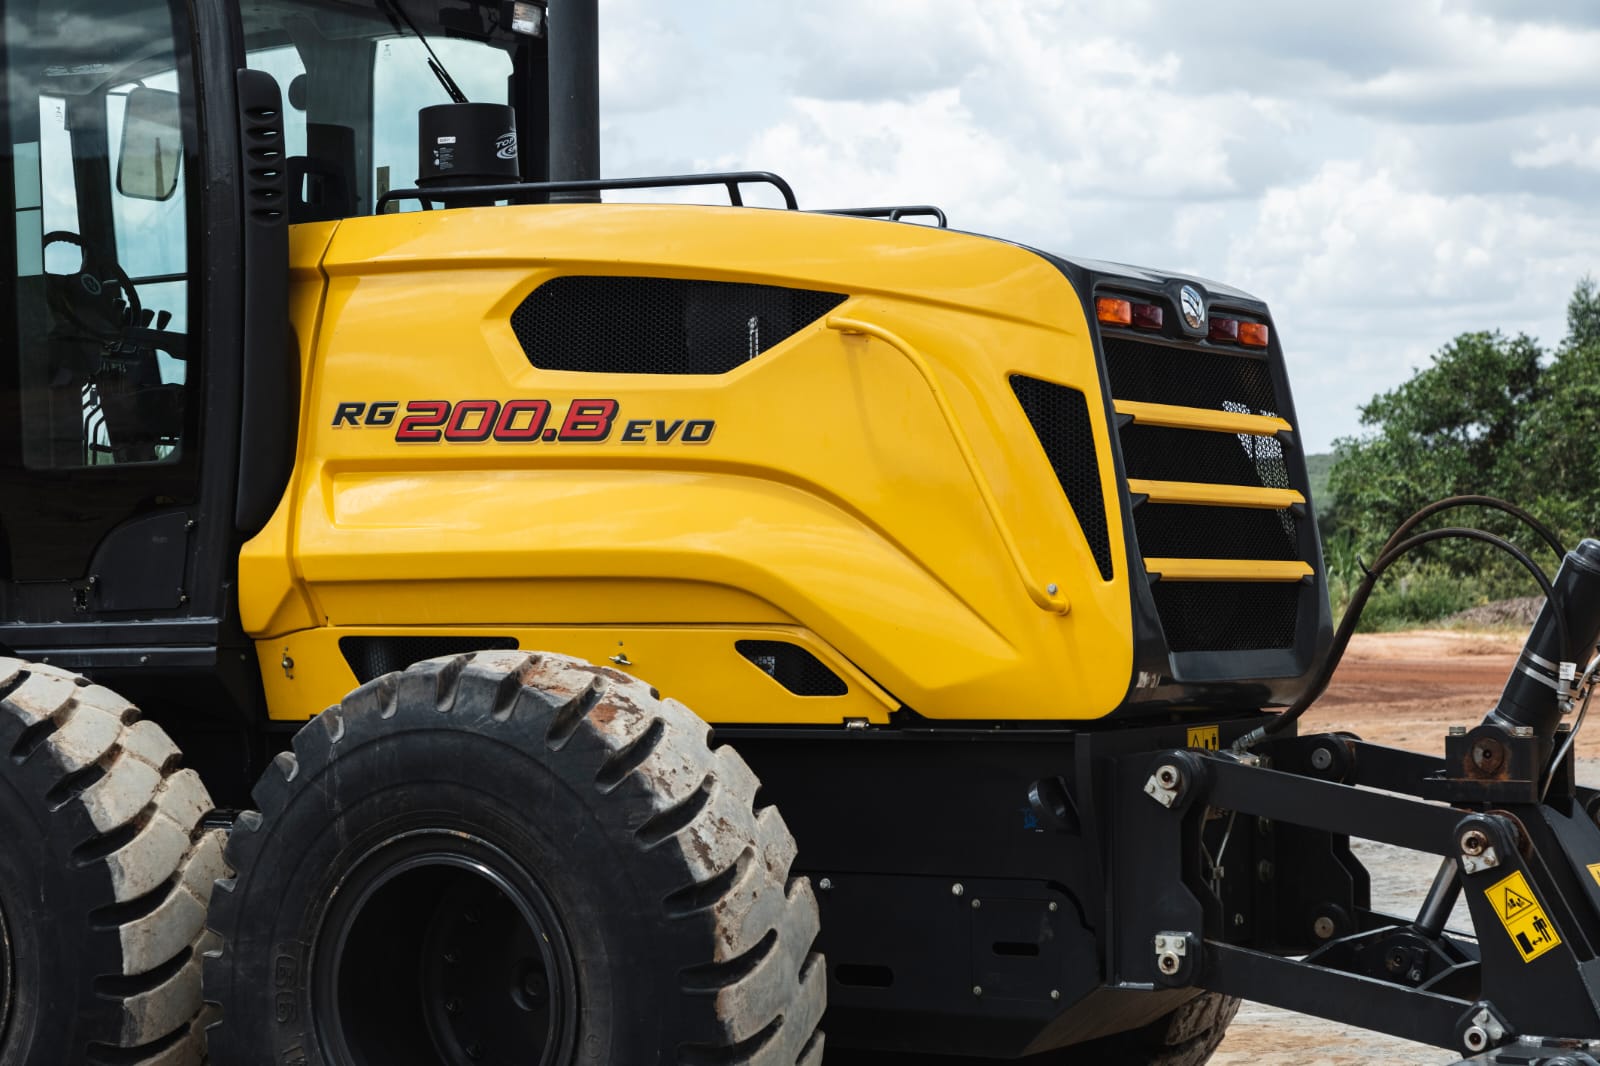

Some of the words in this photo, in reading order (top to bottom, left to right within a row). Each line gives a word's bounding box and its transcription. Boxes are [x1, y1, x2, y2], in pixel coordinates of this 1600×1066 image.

[331, 402, 399, 426] RG
[395, 399, 619, 443] 200.B
[621, 420, 716, 442] EVO
